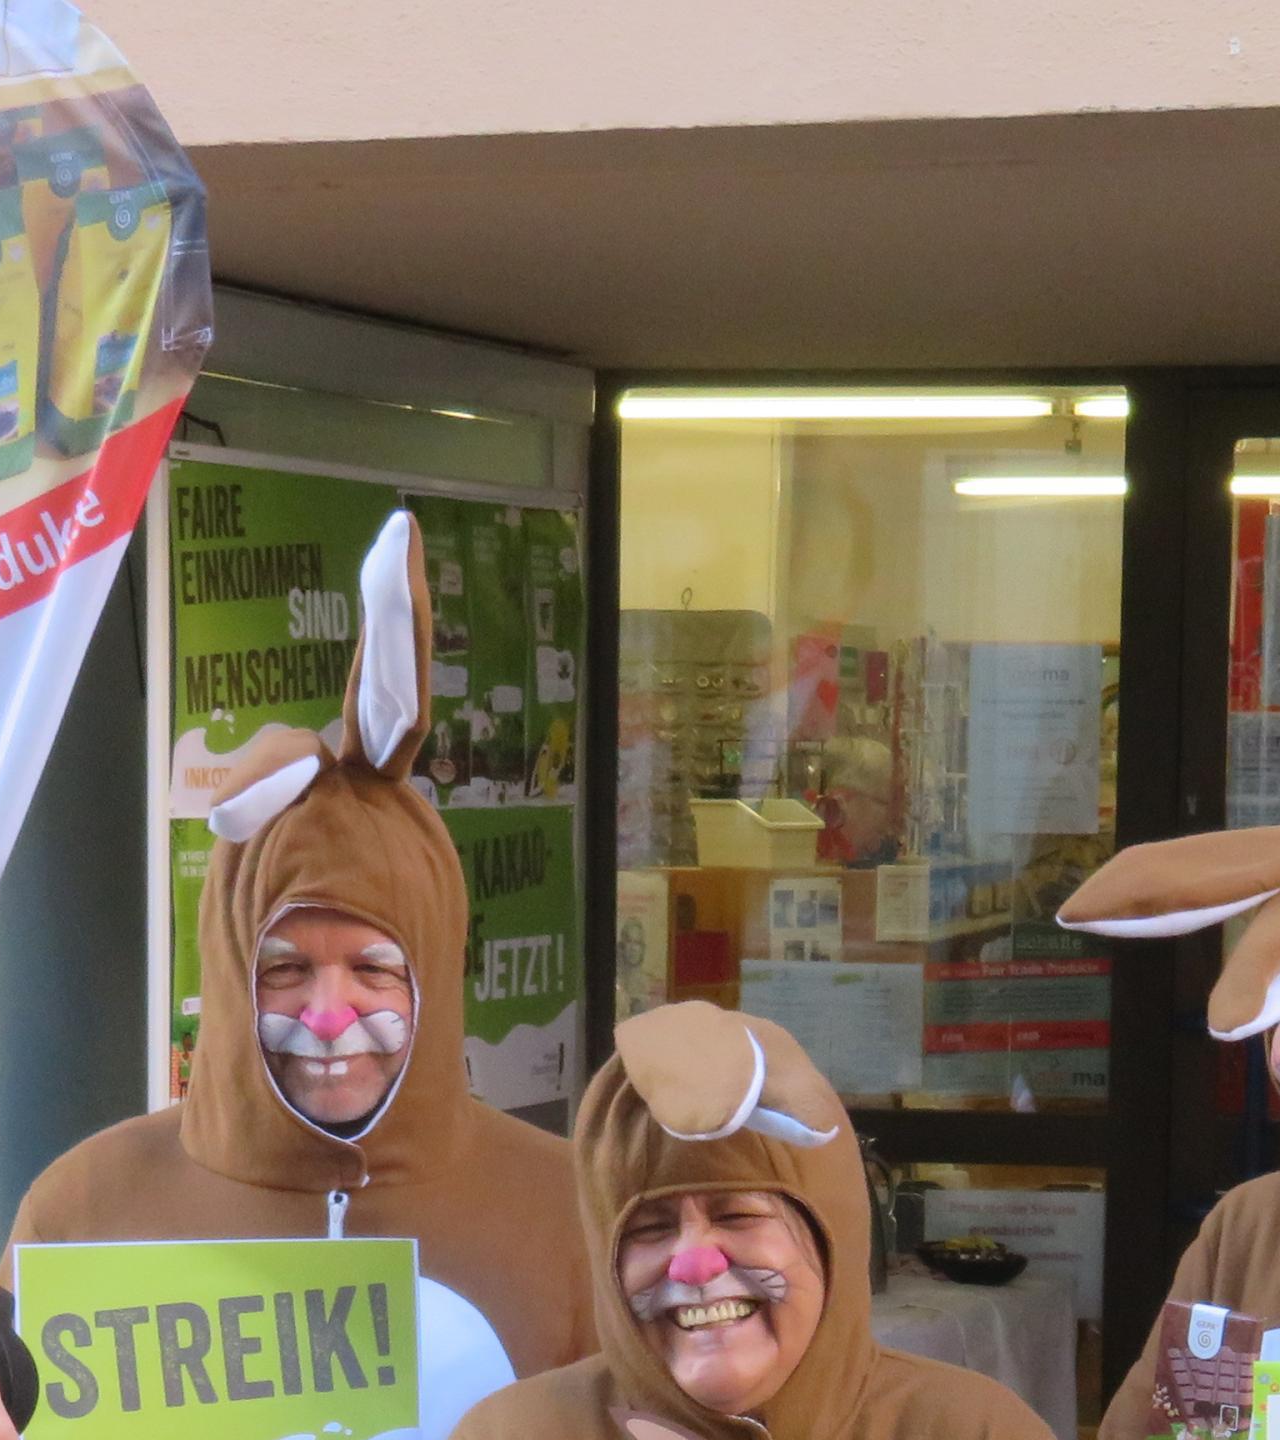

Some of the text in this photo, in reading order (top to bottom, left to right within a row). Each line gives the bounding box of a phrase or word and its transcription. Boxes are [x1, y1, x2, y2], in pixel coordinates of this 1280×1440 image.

[176, 483, 247, 541] FAIRE
[181, 543, 322, 606] EINKOMMEN
[288, 587, 349, 641] SIND
[474, 934, 565, 1002] JETZT!
[41, 1283, 396, 1419] STREIK!
